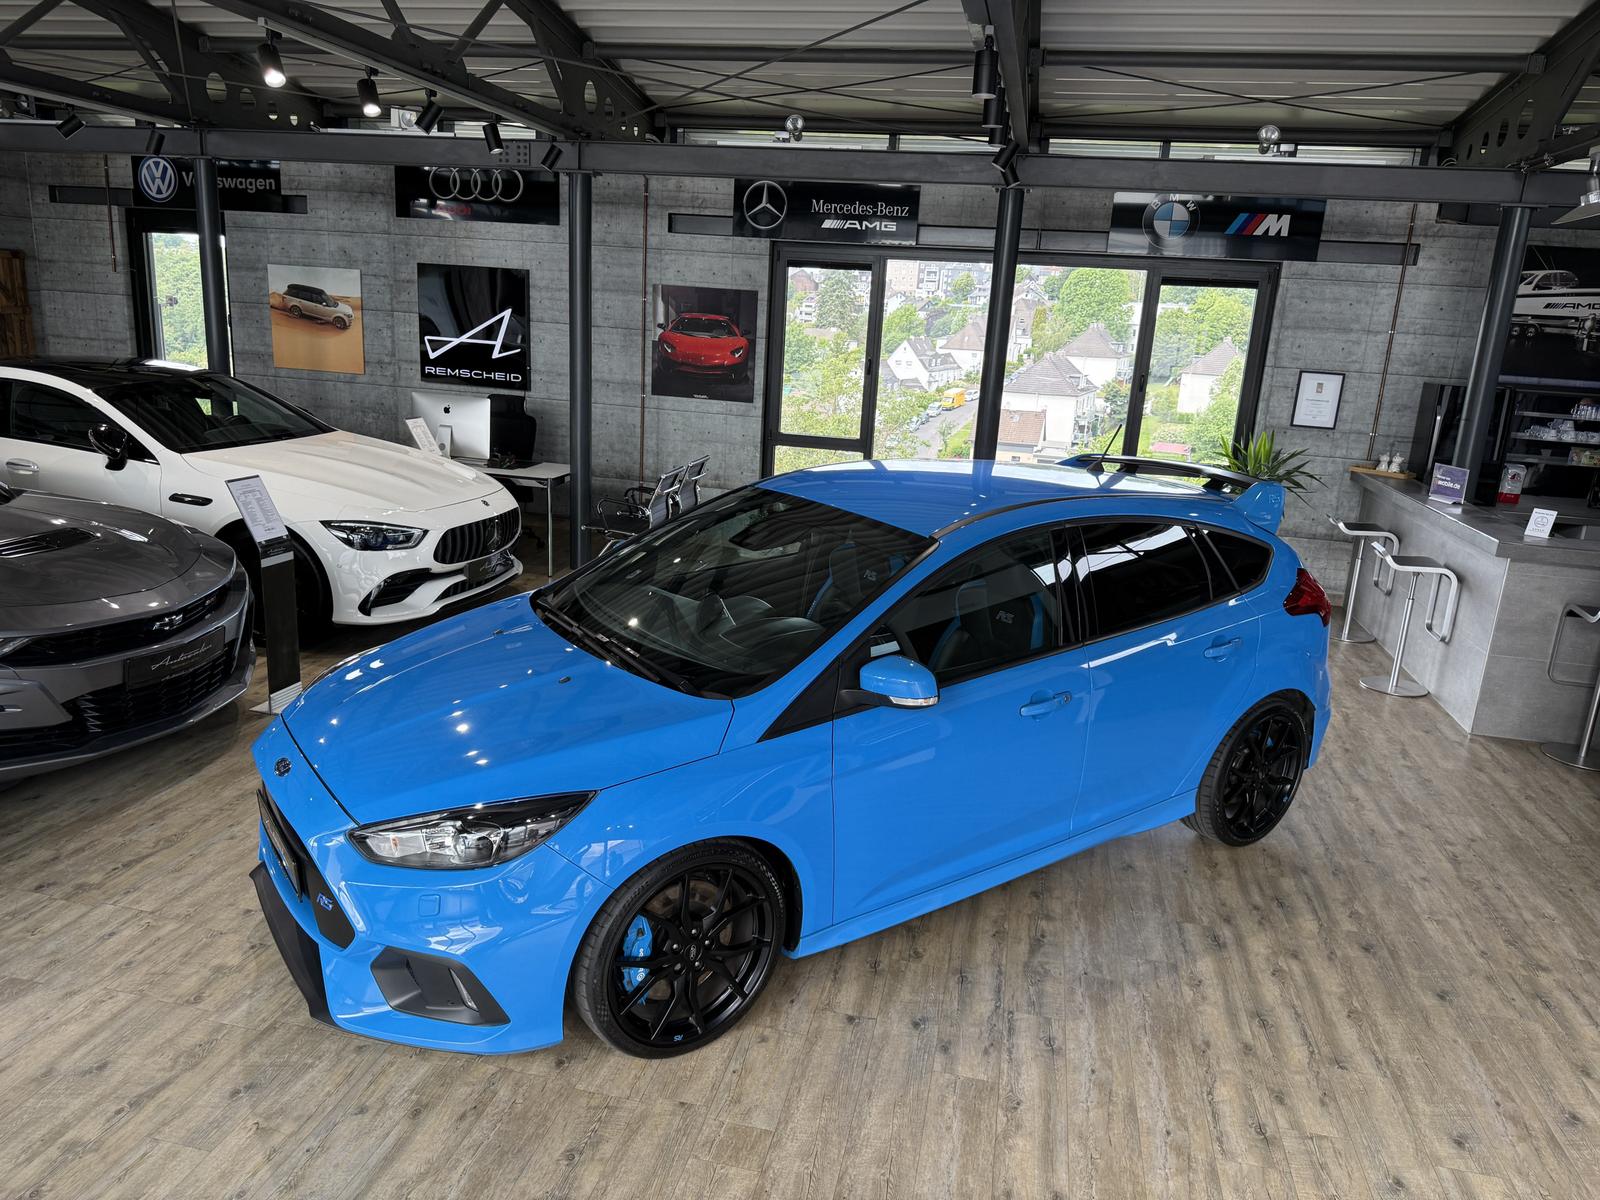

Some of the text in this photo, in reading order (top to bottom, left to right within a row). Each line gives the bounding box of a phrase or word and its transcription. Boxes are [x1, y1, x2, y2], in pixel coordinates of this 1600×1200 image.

[182, 172, 275, 193] Vswagen
[811, 199, 909, 217] Mercedes-Benz
[843, 220, 897, 231] AMG
[425, 366, 522, 382] REMSCHEID
[316, 892, 334, 911] RS
